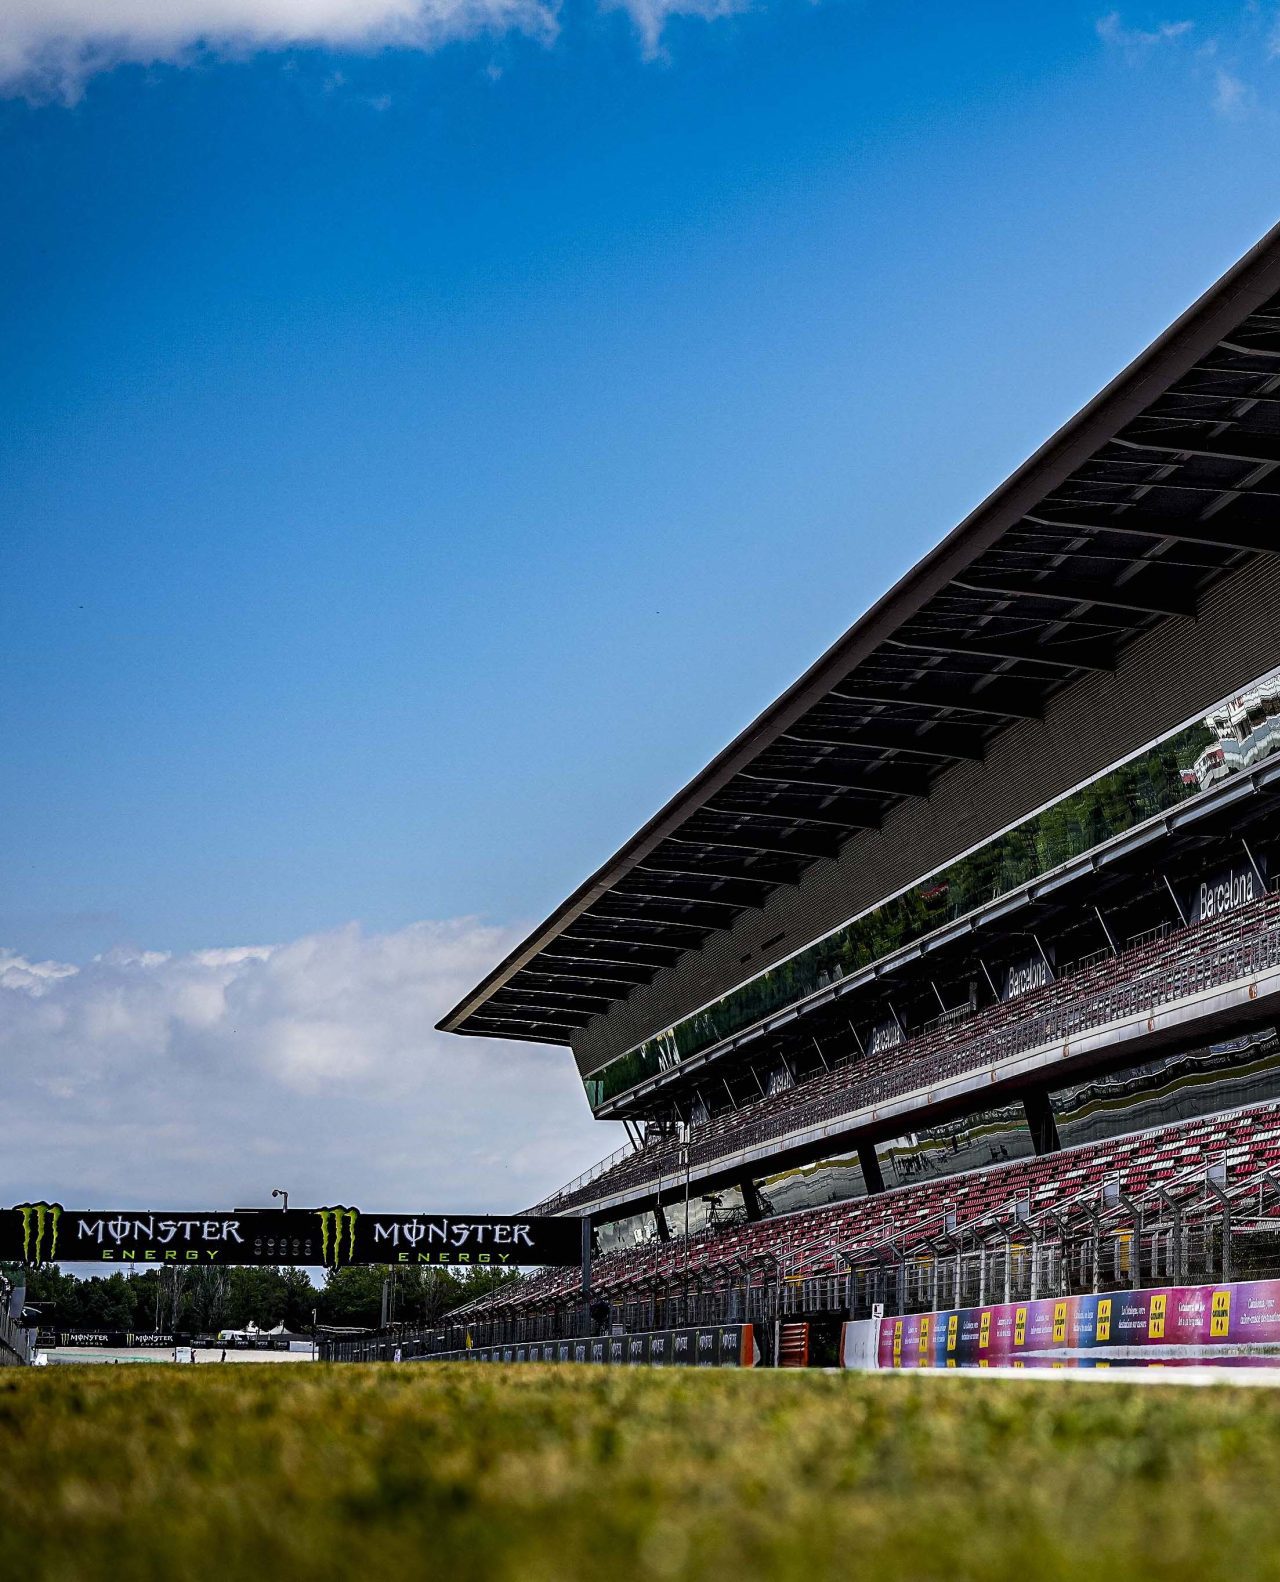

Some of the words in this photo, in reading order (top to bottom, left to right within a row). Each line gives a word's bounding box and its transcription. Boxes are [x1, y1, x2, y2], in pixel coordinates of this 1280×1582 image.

[1200, 869, 1253, 920] Barcelona
[1009, 958, 1046, 998] Barcelona
[78, 1215, 245, 1244] MONSTER
[374, 1218, 535, 1247] MONSTER
[102, 1250, 219, 1260] ENERGY
[398, 1252, 511, 1262] ENERGY
